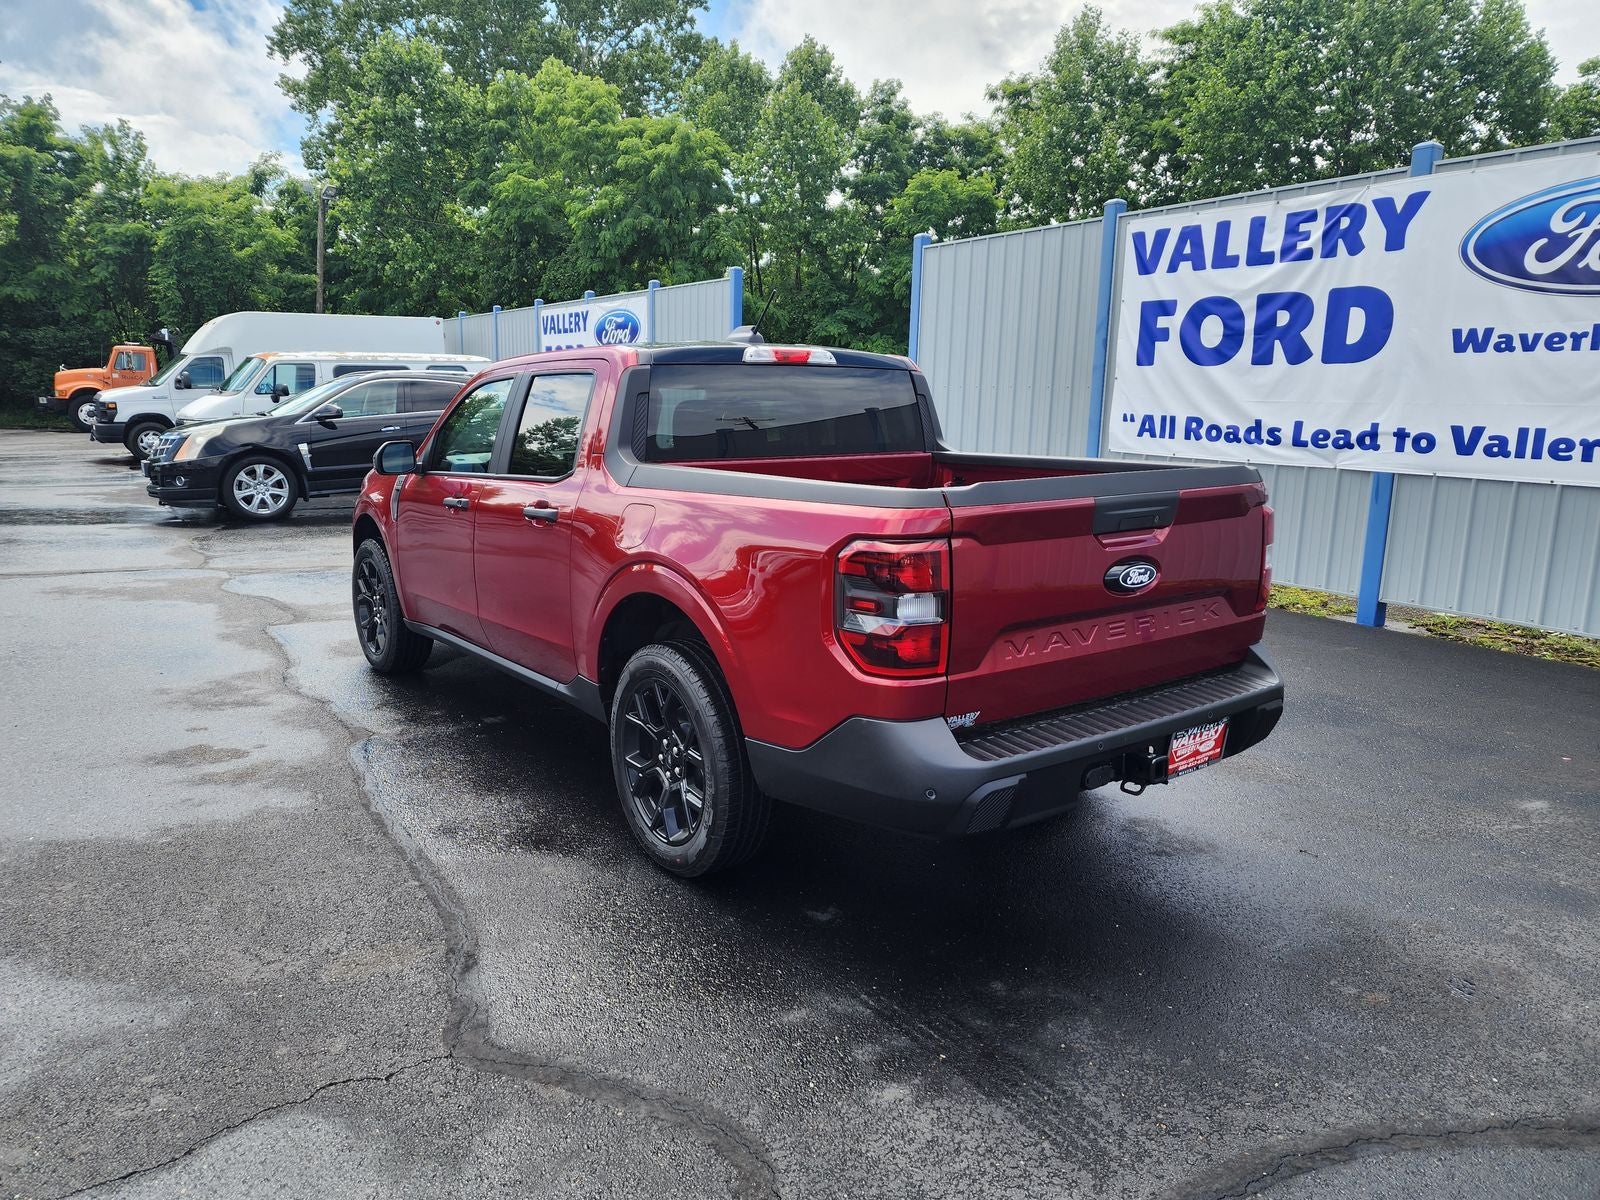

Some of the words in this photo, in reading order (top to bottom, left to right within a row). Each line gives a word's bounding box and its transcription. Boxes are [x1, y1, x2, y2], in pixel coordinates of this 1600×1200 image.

[1132, 190, 1432, 276] VALLERY
[542, 310, 589, 335] VALLERY
[602, 316, 632, 343] Ford
[1136, 285, 1395, 367] FORD
[1183, 416, 1282, 447] Roads
[1291, 420, 1381, 452] Lead
[1392, 427, 1437, 455] to
[1127, 568, 1151, 584] Ford
[1004, 601, 1223, 661] MAVERICK
